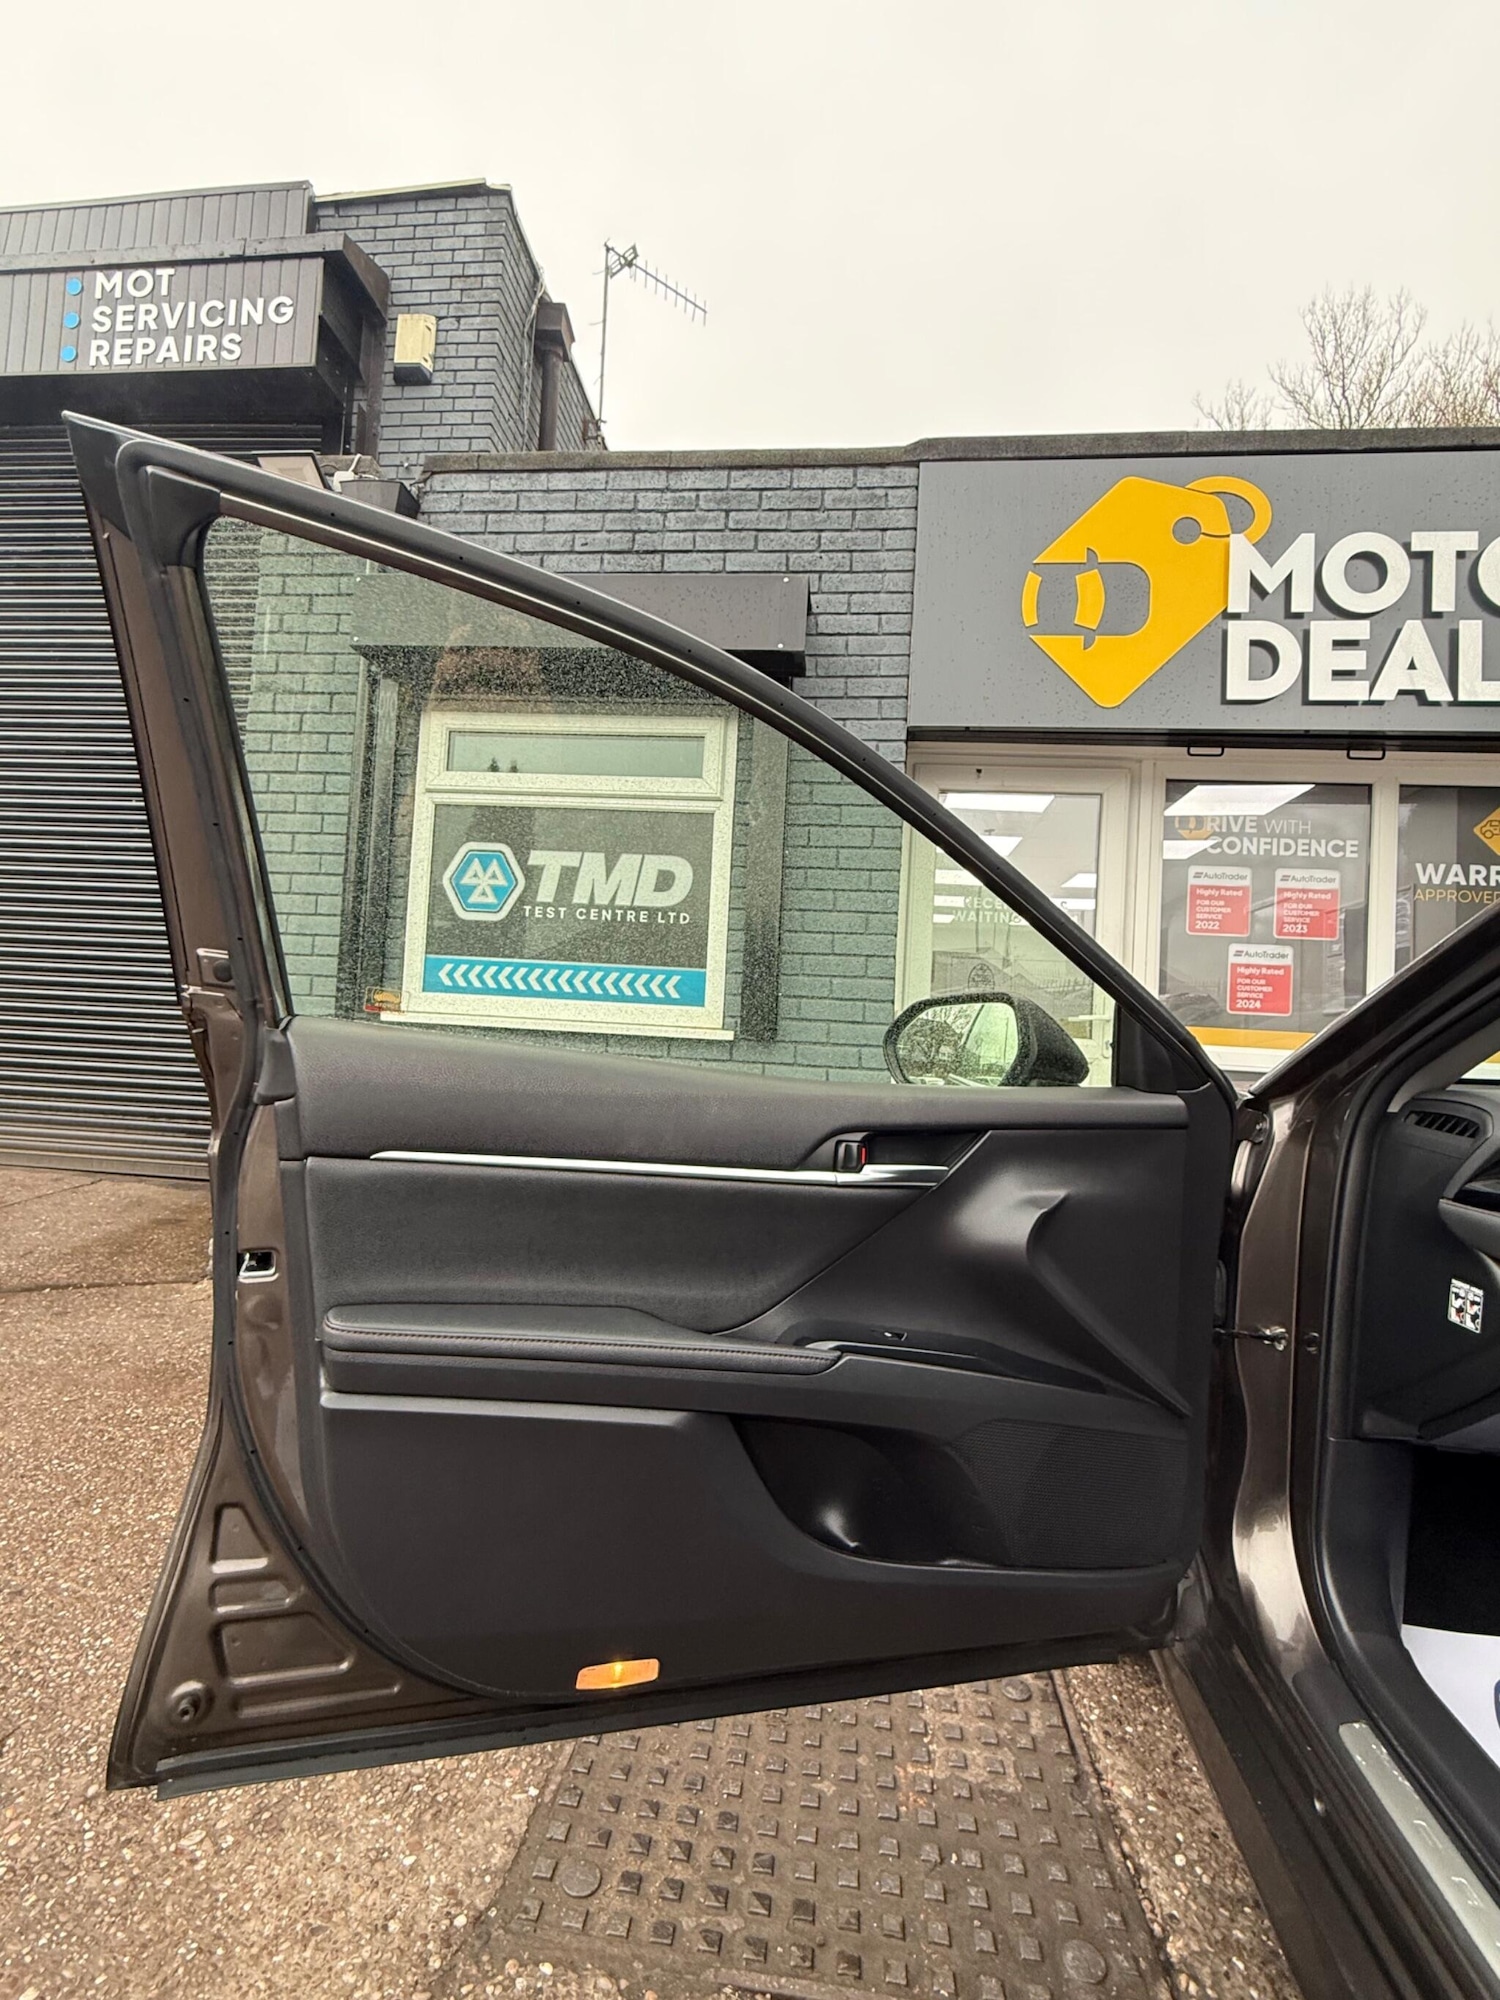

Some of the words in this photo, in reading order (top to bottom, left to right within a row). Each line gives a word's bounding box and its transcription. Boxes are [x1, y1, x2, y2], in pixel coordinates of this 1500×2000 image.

[95, 268, 175, 299] MOT
[91, 296, 295, 333] SERVICING
[89, 333, 242, 367] REPAIRS
[1227, 531, 1500, 614] MOT
[1226, 619, 1500, 702] DEAL
[1264, 819, 1312, 835] WITH
[1207, 836, 1359, 858] CONFIDENCE
[527, 850, 694, 908] TMD
[1203, 872, 1248, 881] AutoTrader
[1291, 875, 1337, 884] AutoTrader
[1196, 888, 1219, 897] Highly
[1220, 889, 1243, 897] Rated
[1283, 892, 1307, 900] Highly
[523, 906, 567, 920] TEST
[576, 908, 648, 923] CENTRE
[658, 912, 690, 925] LTD
[1195, 920, 1220, 930] 2022
[1282, 924, 1308, 933] 2023
[1244, 951, 1289, 960] AutoTrader
[1236, 966, 1260, 976] Highly
[1261, 967, 1285, 976] Rated
[1235, 1000, 1261, 1009] 2024
